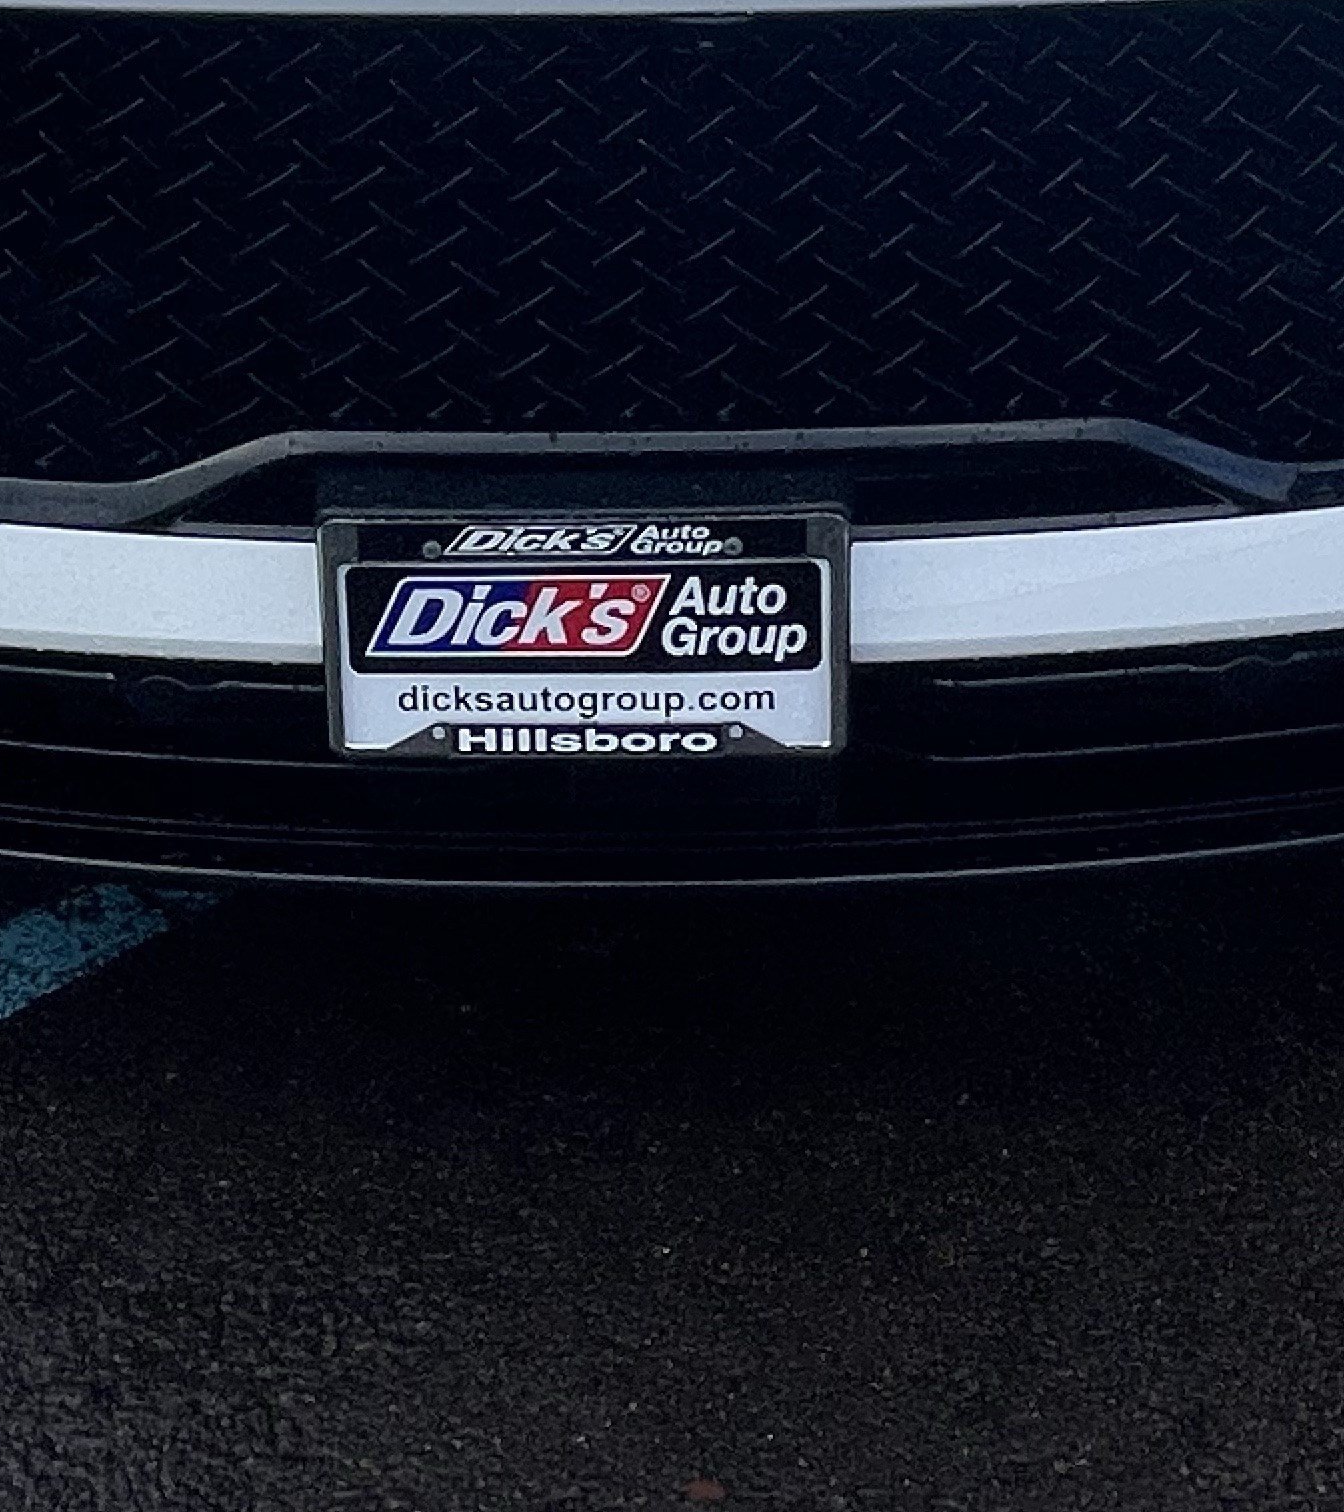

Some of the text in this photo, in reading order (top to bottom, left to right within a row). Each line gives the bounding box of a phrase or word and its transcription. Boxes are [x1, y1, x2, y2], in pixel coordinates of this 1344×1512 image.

[630, 524, 711, 539] Auto
[630, 536, 723, 556] Group
[387, 576, 787, 645] Dick's Auto
[661, 617, 807, 662] Group
[397, 684, 776, 719] dicksautogroup.com
[457, 726, 718, 754] Hillsboro
